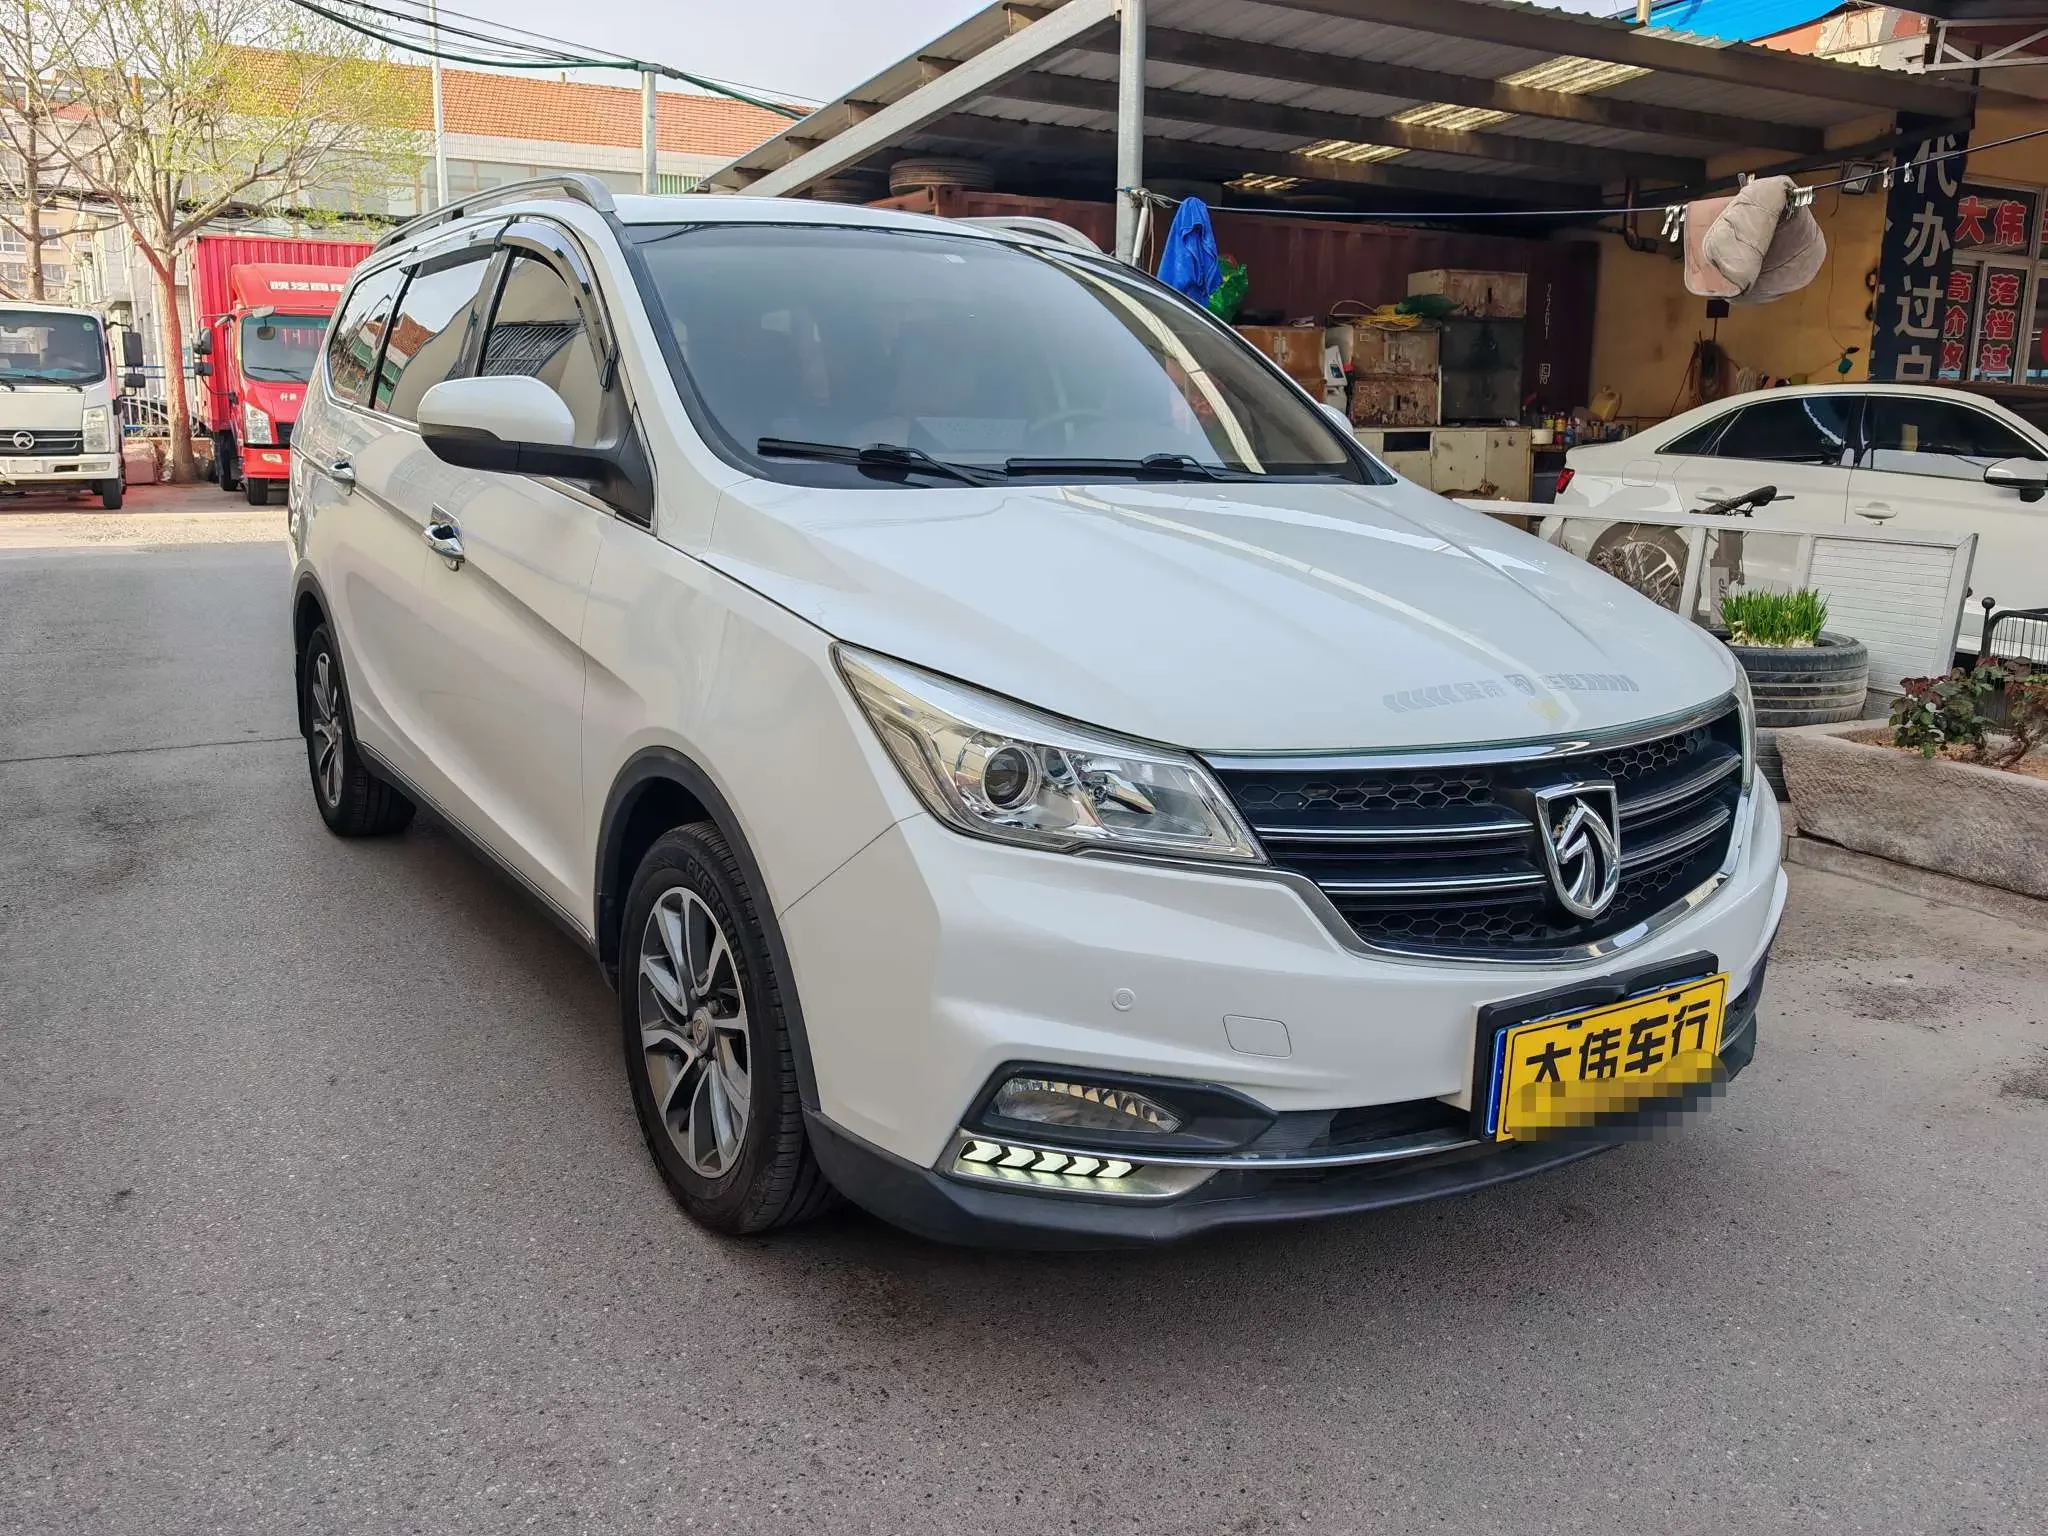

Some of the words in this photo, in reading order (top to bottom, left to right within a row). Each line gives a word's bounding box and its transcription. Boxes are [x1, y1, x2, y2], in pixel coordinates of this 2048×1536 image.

[1955, 195, 2027, 246] 大伟
[1936, 271, 1973, 383] 高价收
[1980, 274, 2021, 382] 落档过
[1526, 999, 1711, 1082] 大伟车行
